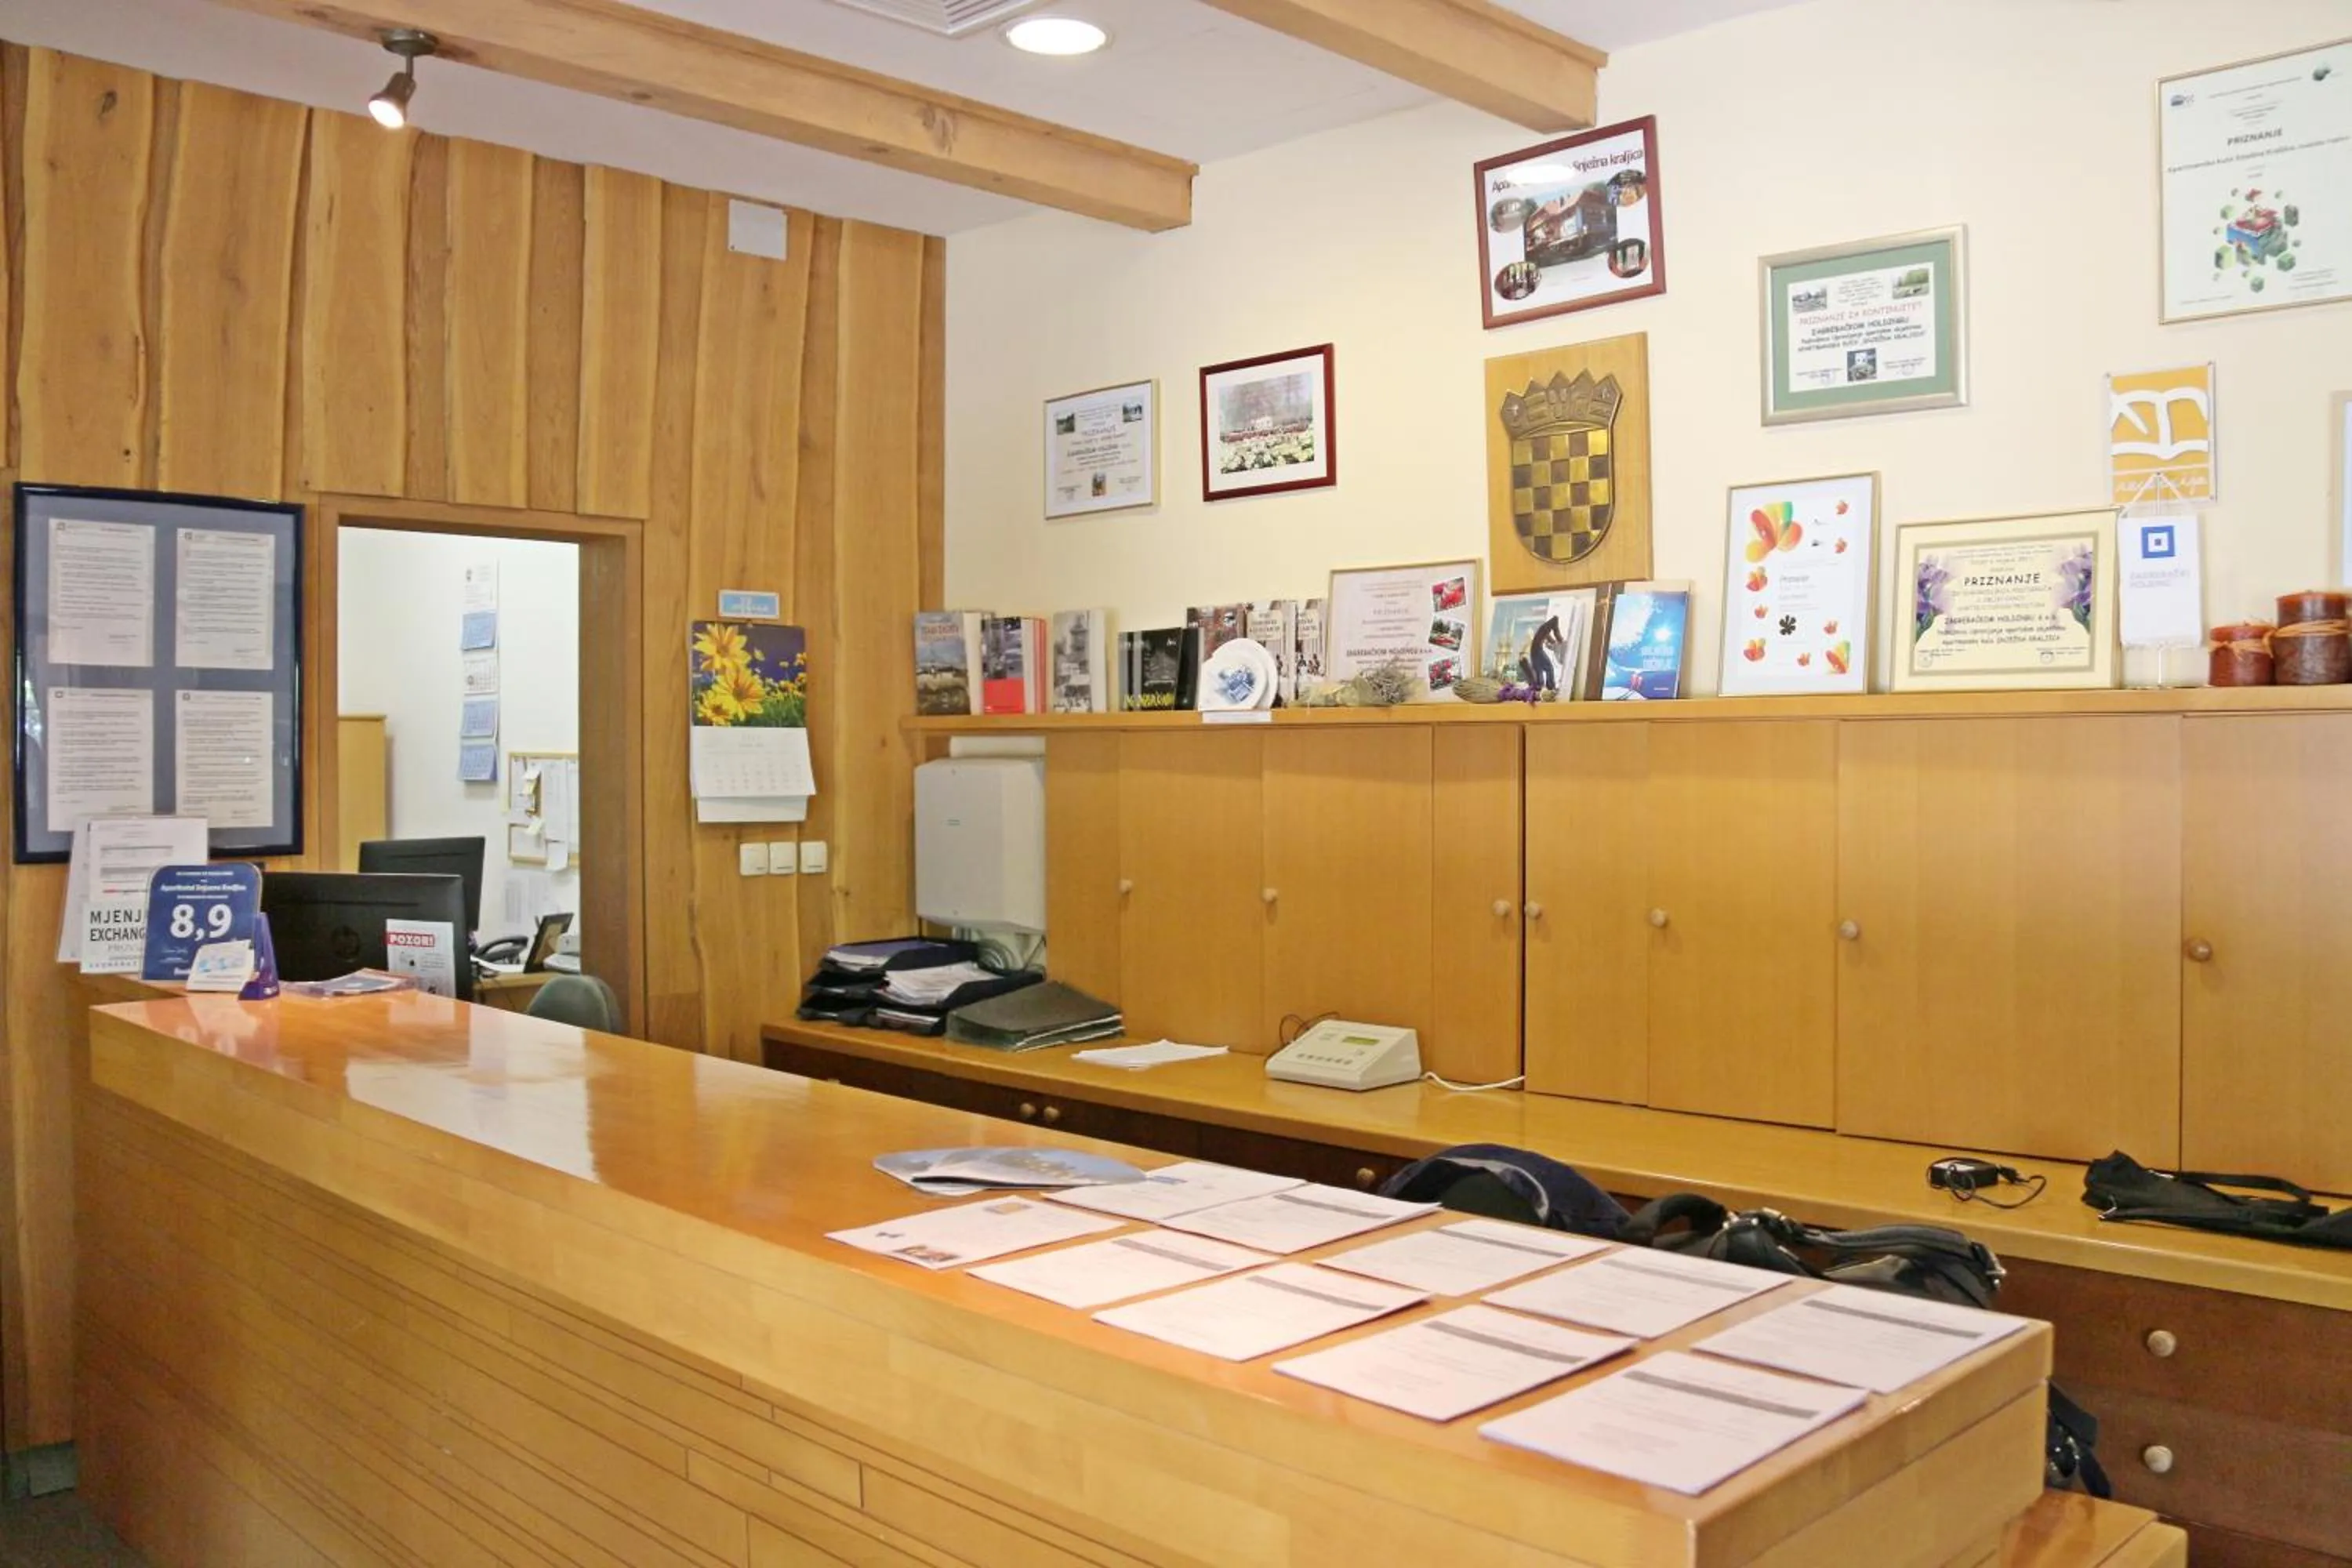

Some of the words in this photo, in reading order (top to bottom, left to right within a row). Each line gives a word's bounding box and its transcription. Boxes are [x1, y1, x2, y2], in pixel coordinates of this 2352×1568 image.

[2227, 128, 2284, 147] PRIZNANJE
[1963, 573, 2041, 586] PRIZNANJE
[89, 909, 143, 924] MJENJ
[169, 904, 233, 942] 8,9
[89, 927, 146, 942] EXCHANG
